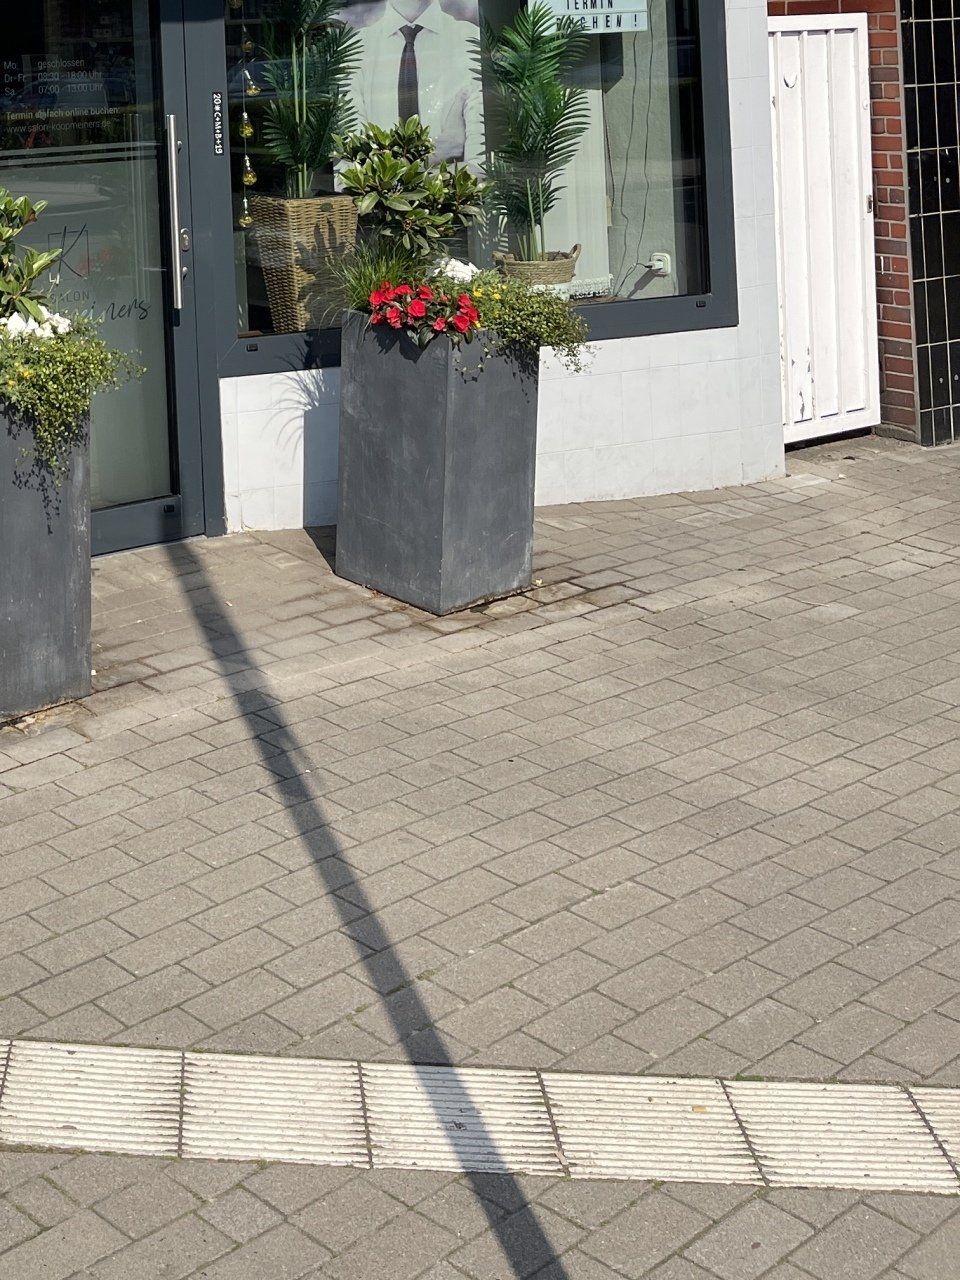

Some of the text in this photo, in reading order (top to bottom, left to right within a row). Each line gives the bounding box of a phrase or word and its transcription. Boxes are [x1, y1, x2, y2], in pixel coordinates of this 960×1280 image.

[3, 59, 85, 70] Mo geschlossen
[6, 111, 33, 120] Termin
[65, 108, 89, 117] online
[50, 290, 90, 304] SALON
